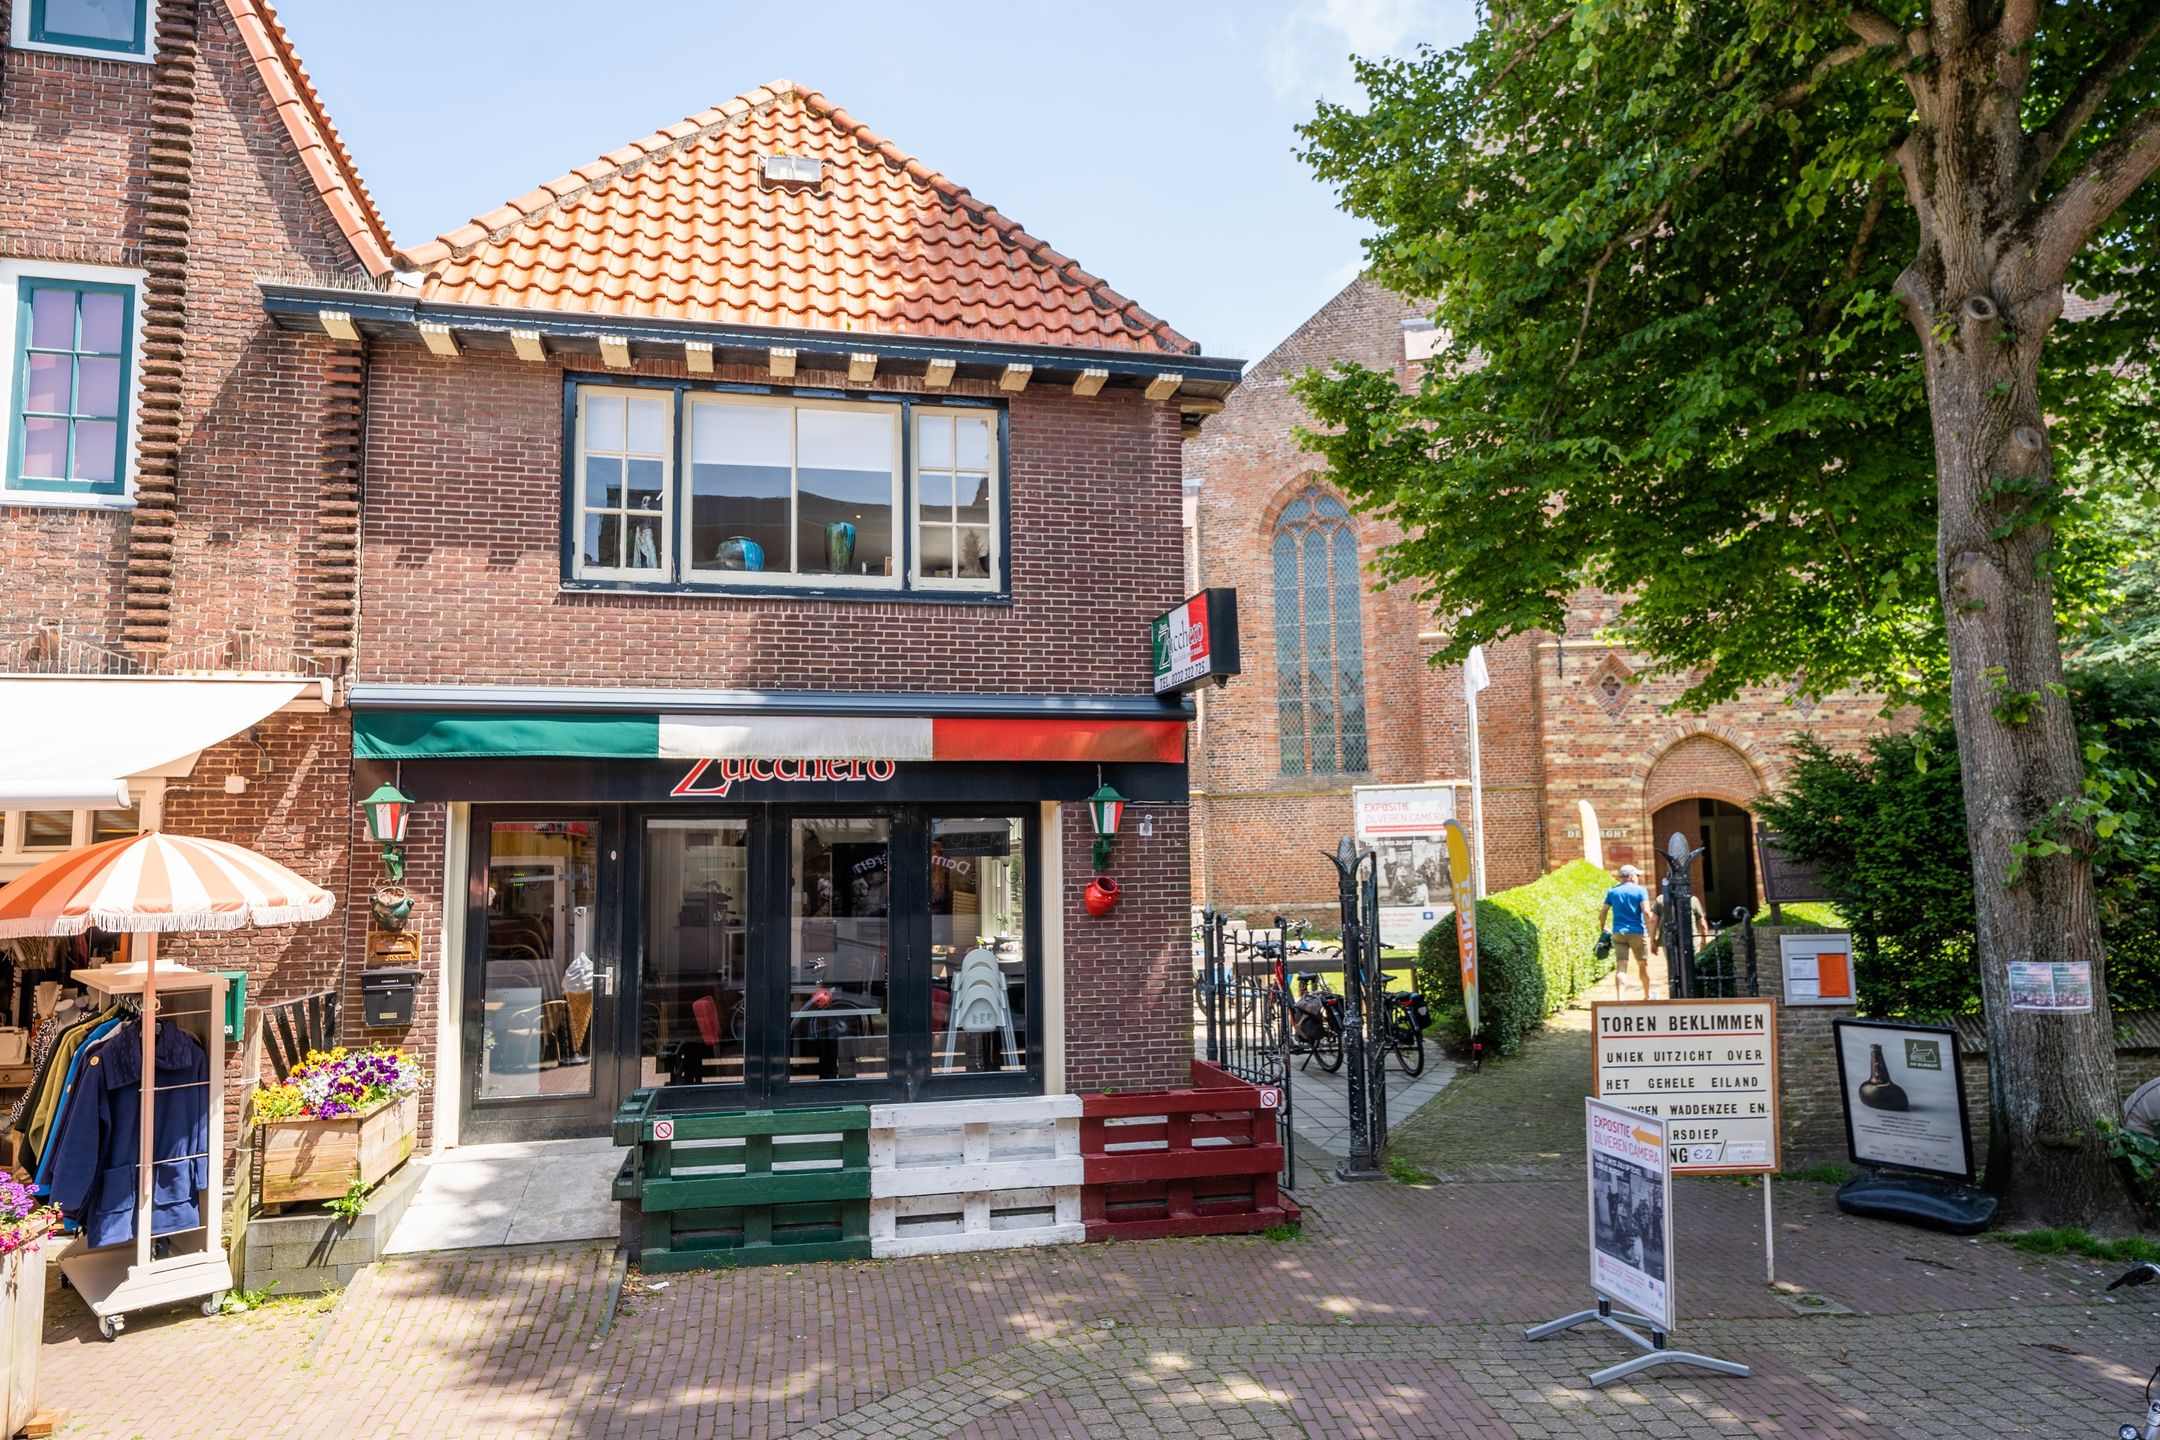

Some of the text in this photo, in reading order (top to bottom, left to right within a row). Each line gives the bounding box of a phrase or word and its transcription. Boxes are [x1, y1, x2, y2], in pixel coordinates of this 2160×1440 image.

[1158, 620, 1204, 670] Zucchero
[1159, 661, 1205, 690] TEL. 0222 322 725
[1364, 802, 1411, 812] EXPOSITIE
[1364, 811, 1446, 824] ZILVEREN CAMERA
[1567, 829, 1628, 838] DE RGHT
[1601, 1014, 1764, 1033] TOREN BEKLIMMEN
[1607, 1050, 1763, 1063] UNIEK UITZICHT OVER
[1606, 1076, 1759, 1090] HET GEHELE EILAND
[1669, 1103, 1738, 1115] WADDENZEE
[1749, 1103, 1765, 1114] EN
[1593, 1115, 1631, 1138] EXPOSITIE
[1671, 1128, 1719, 1141] RSDIEP
[1594, 1130, 1628, 1153] ZILVEREN
[1628, 1142, 1660, 1164] CAMERA
